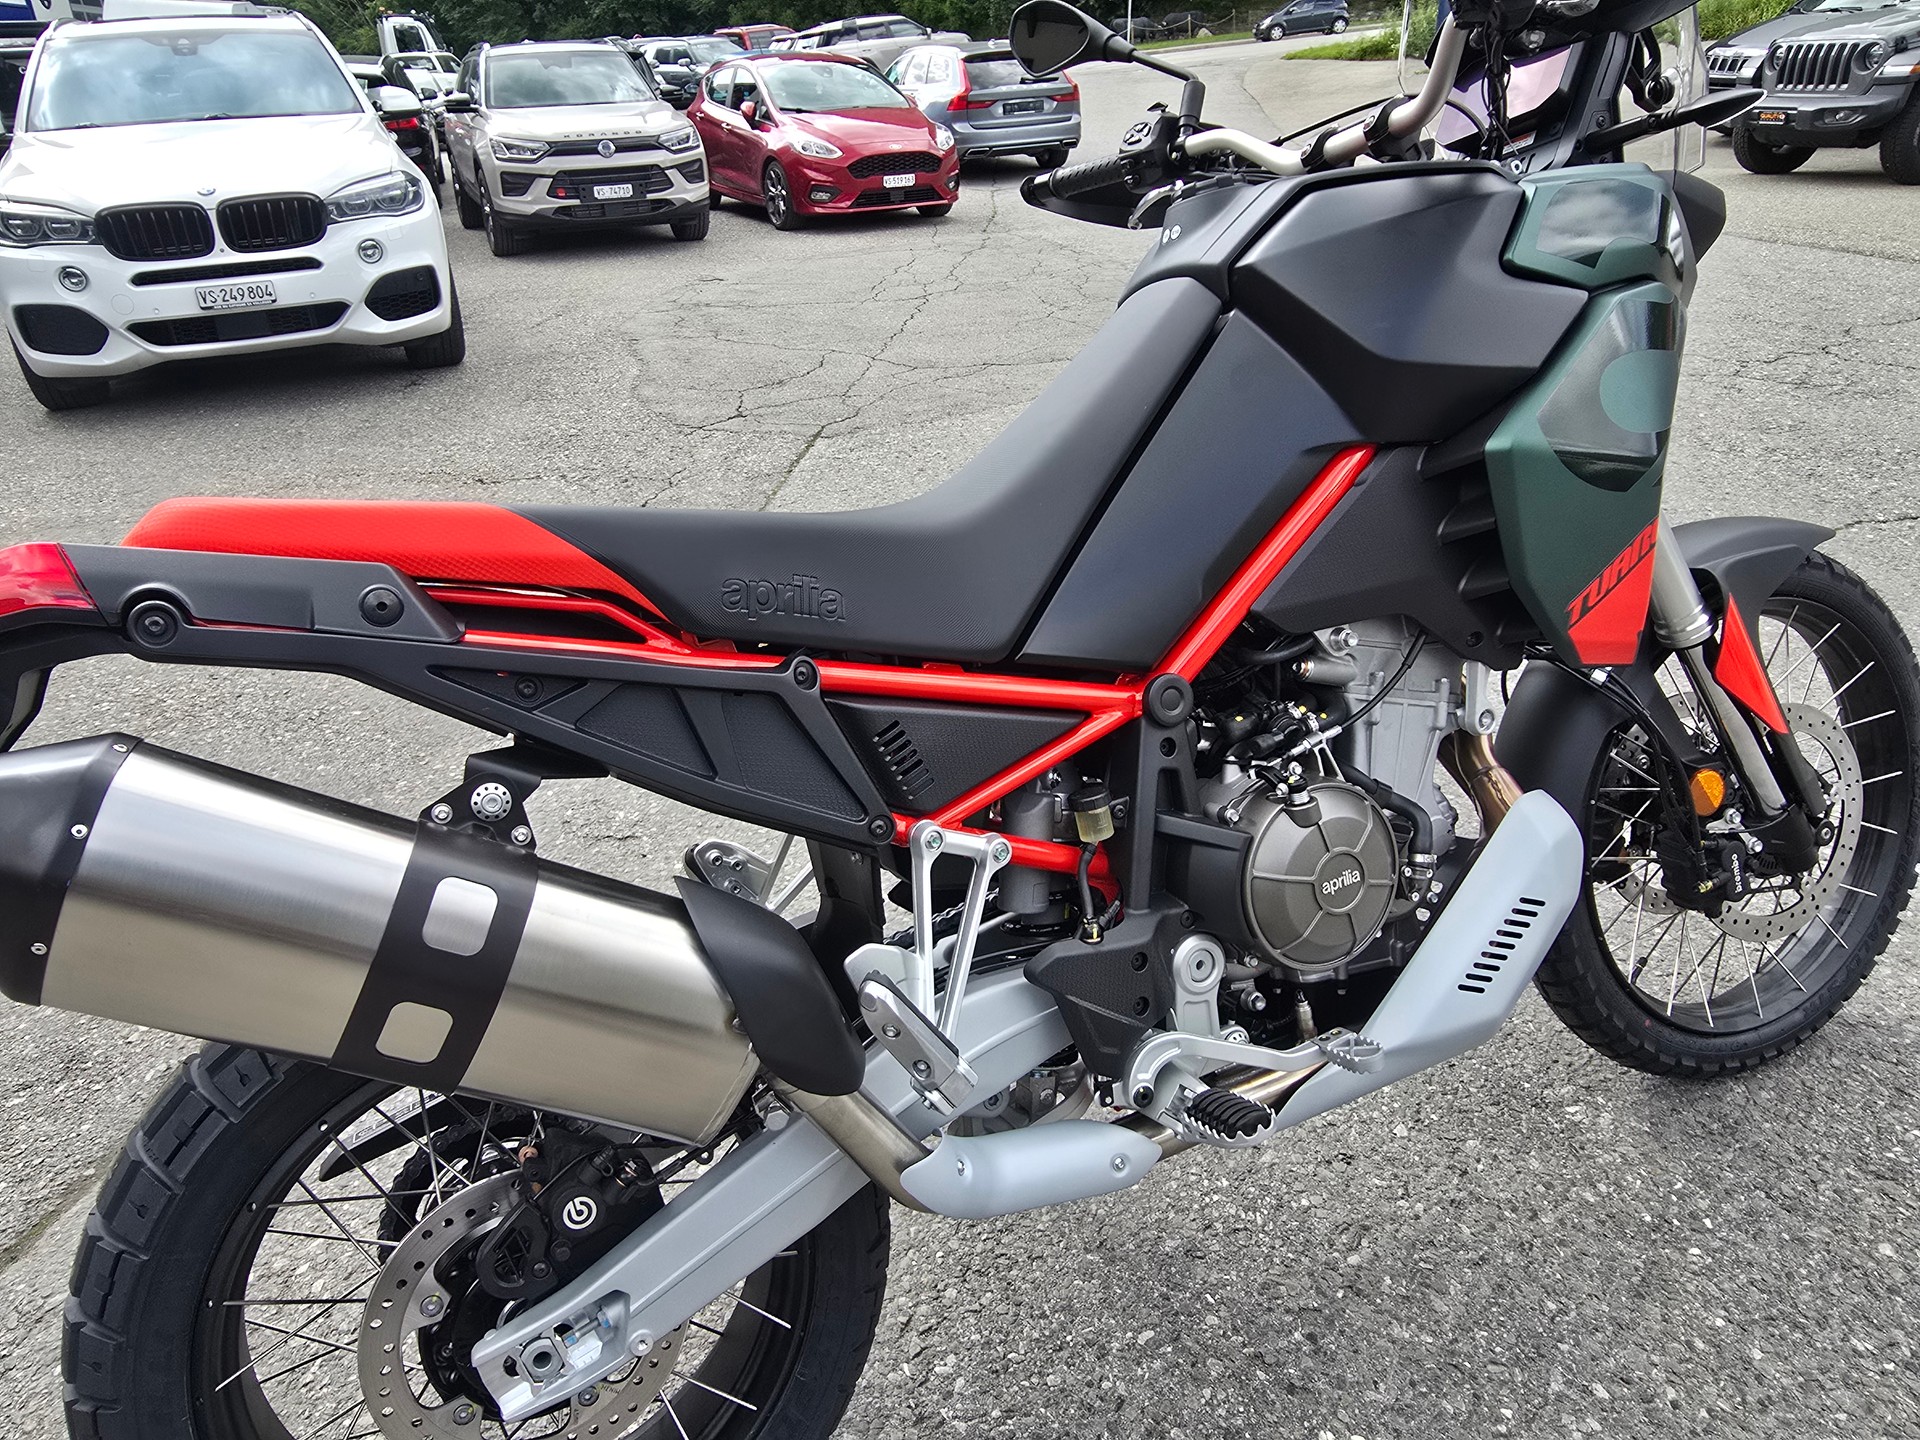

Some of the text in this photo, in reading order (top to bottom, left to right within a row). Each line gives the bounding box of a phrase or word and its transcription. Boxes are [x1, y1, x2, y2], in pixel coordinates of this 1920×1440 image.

[563, 130, 642, 139] KORANDO
[721, 574, 847, 621] aprilia
[1321, 869, 1361, 895] aprilia
[1731, 853, 1743, 894] brembo
